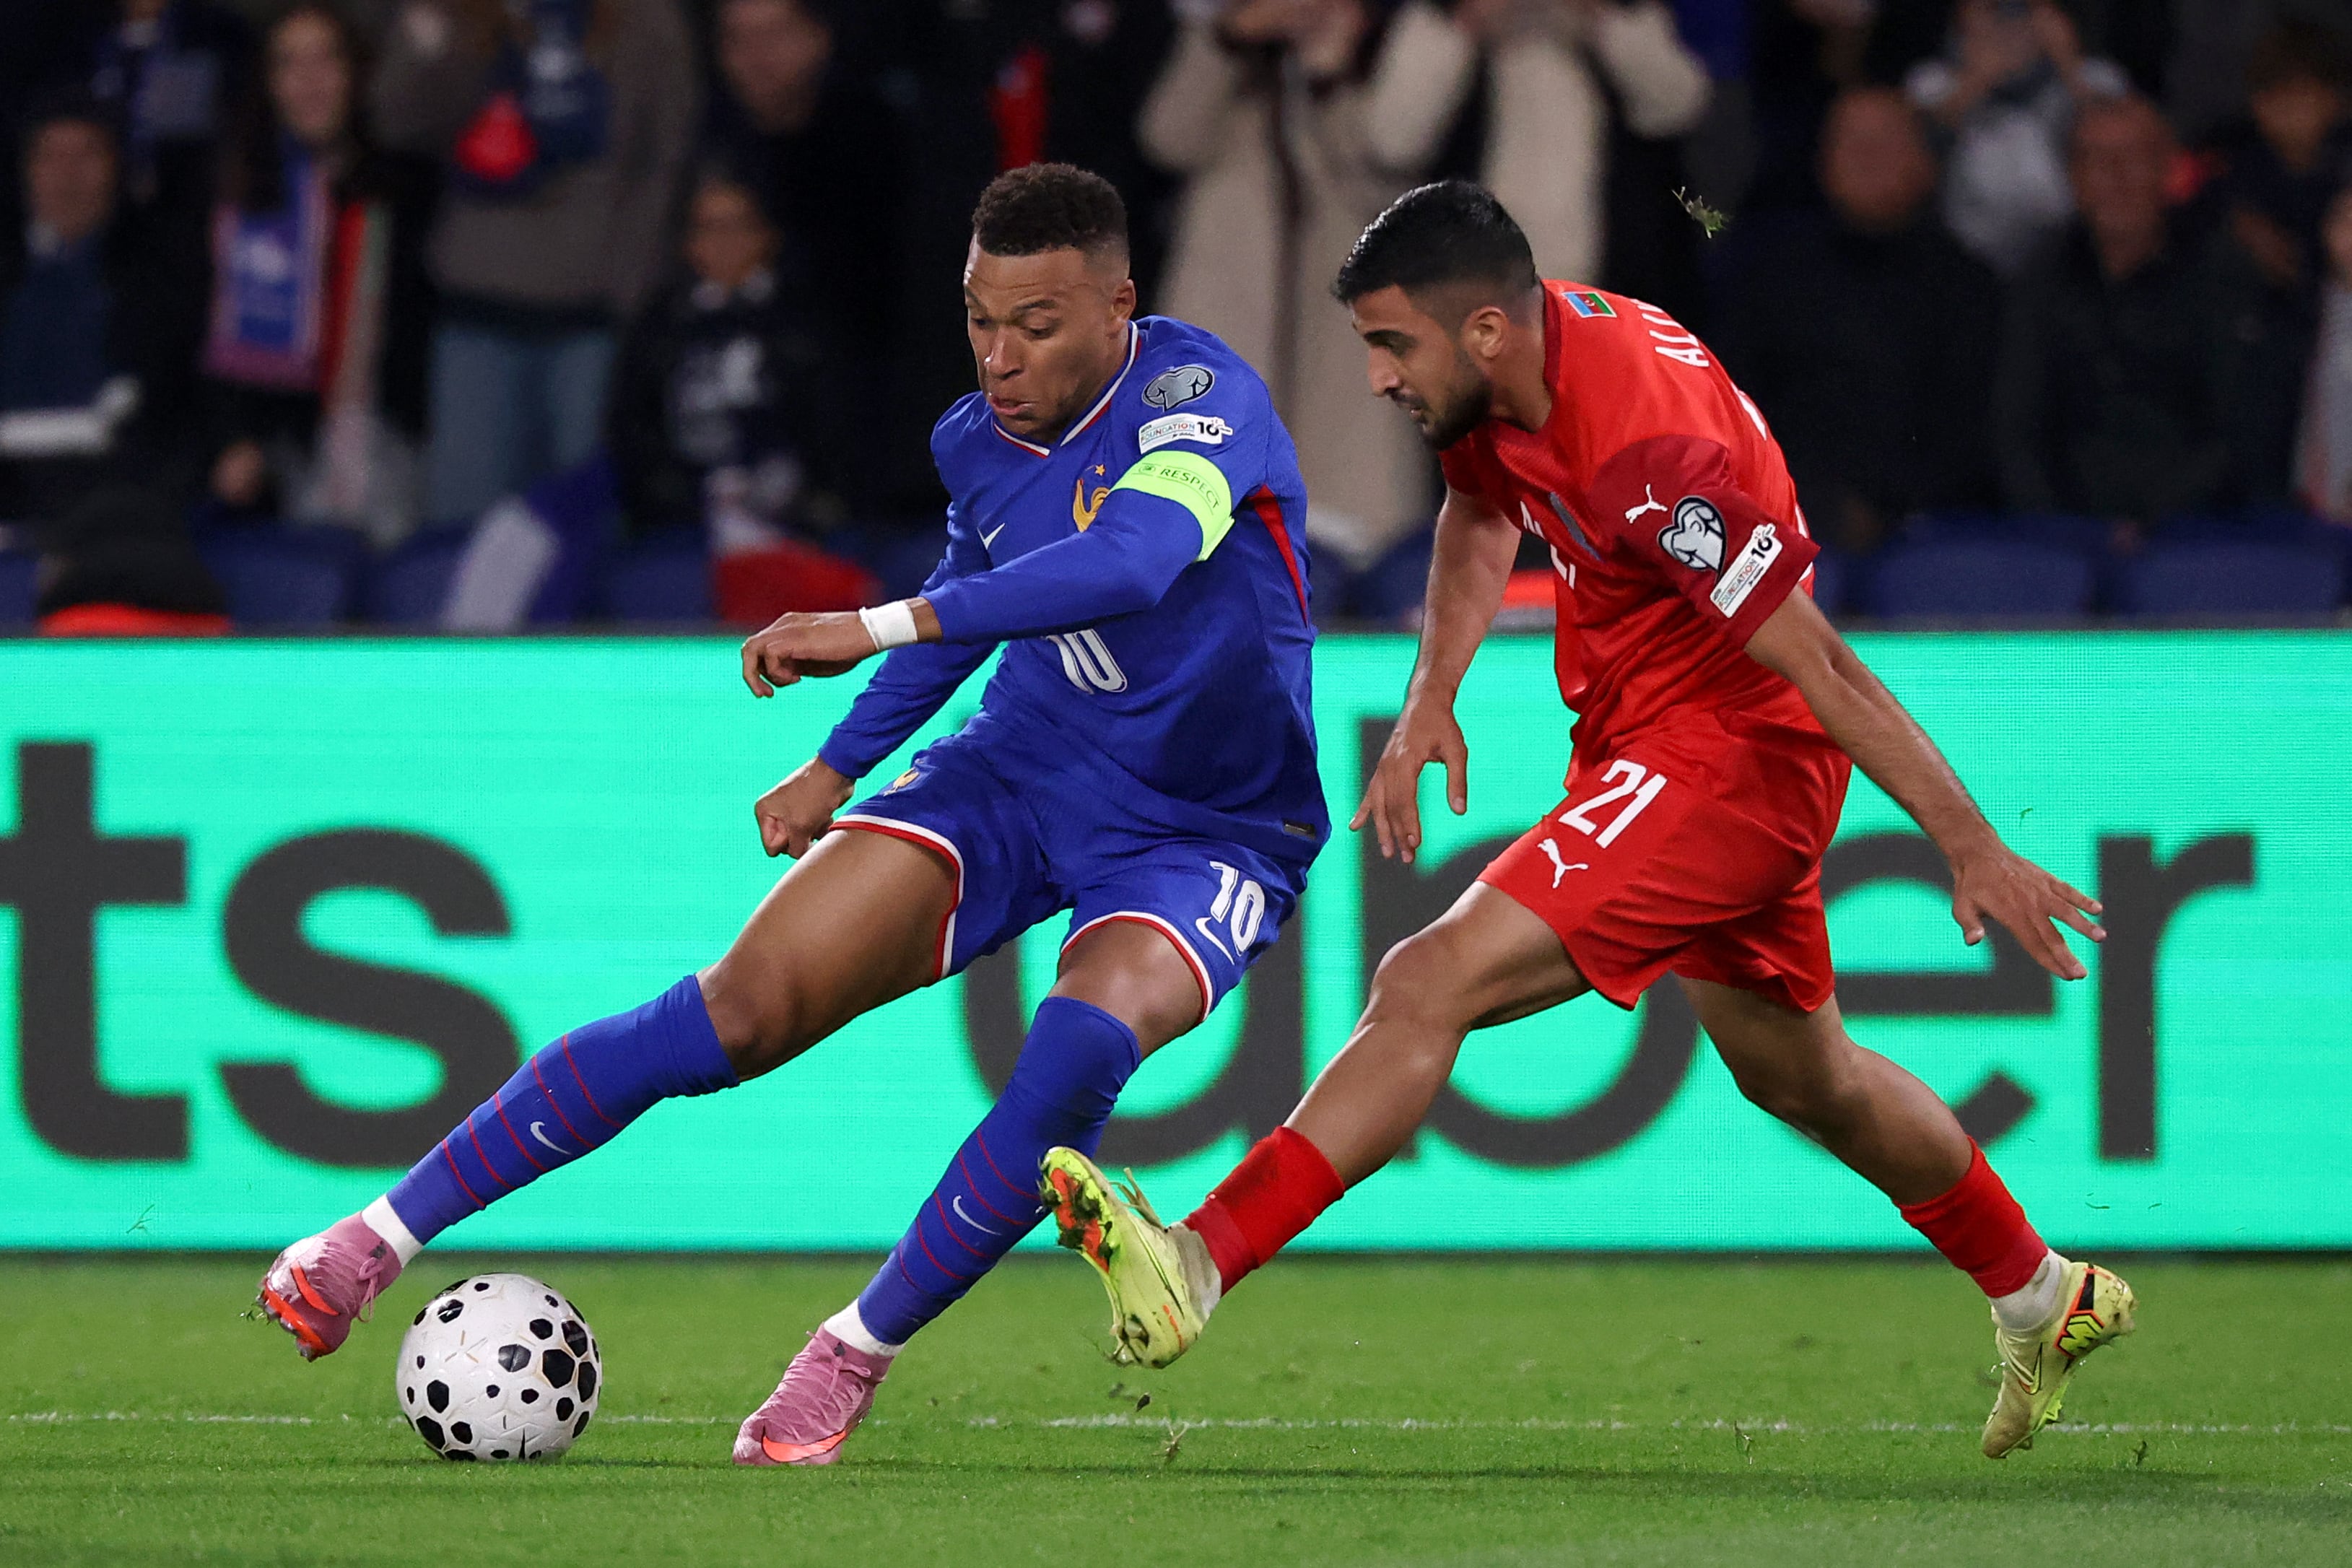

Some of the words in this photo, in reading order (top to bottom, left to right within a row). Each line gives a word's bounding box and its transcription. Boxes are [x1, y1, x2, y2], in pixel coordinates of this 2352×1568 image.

[1160, 469, 1219, 508] RESPECT
[1045, 628, 1128, 694] 10
[1558, 759, 1668, 849] 21
[1210, 861, 1265, 957] 10
